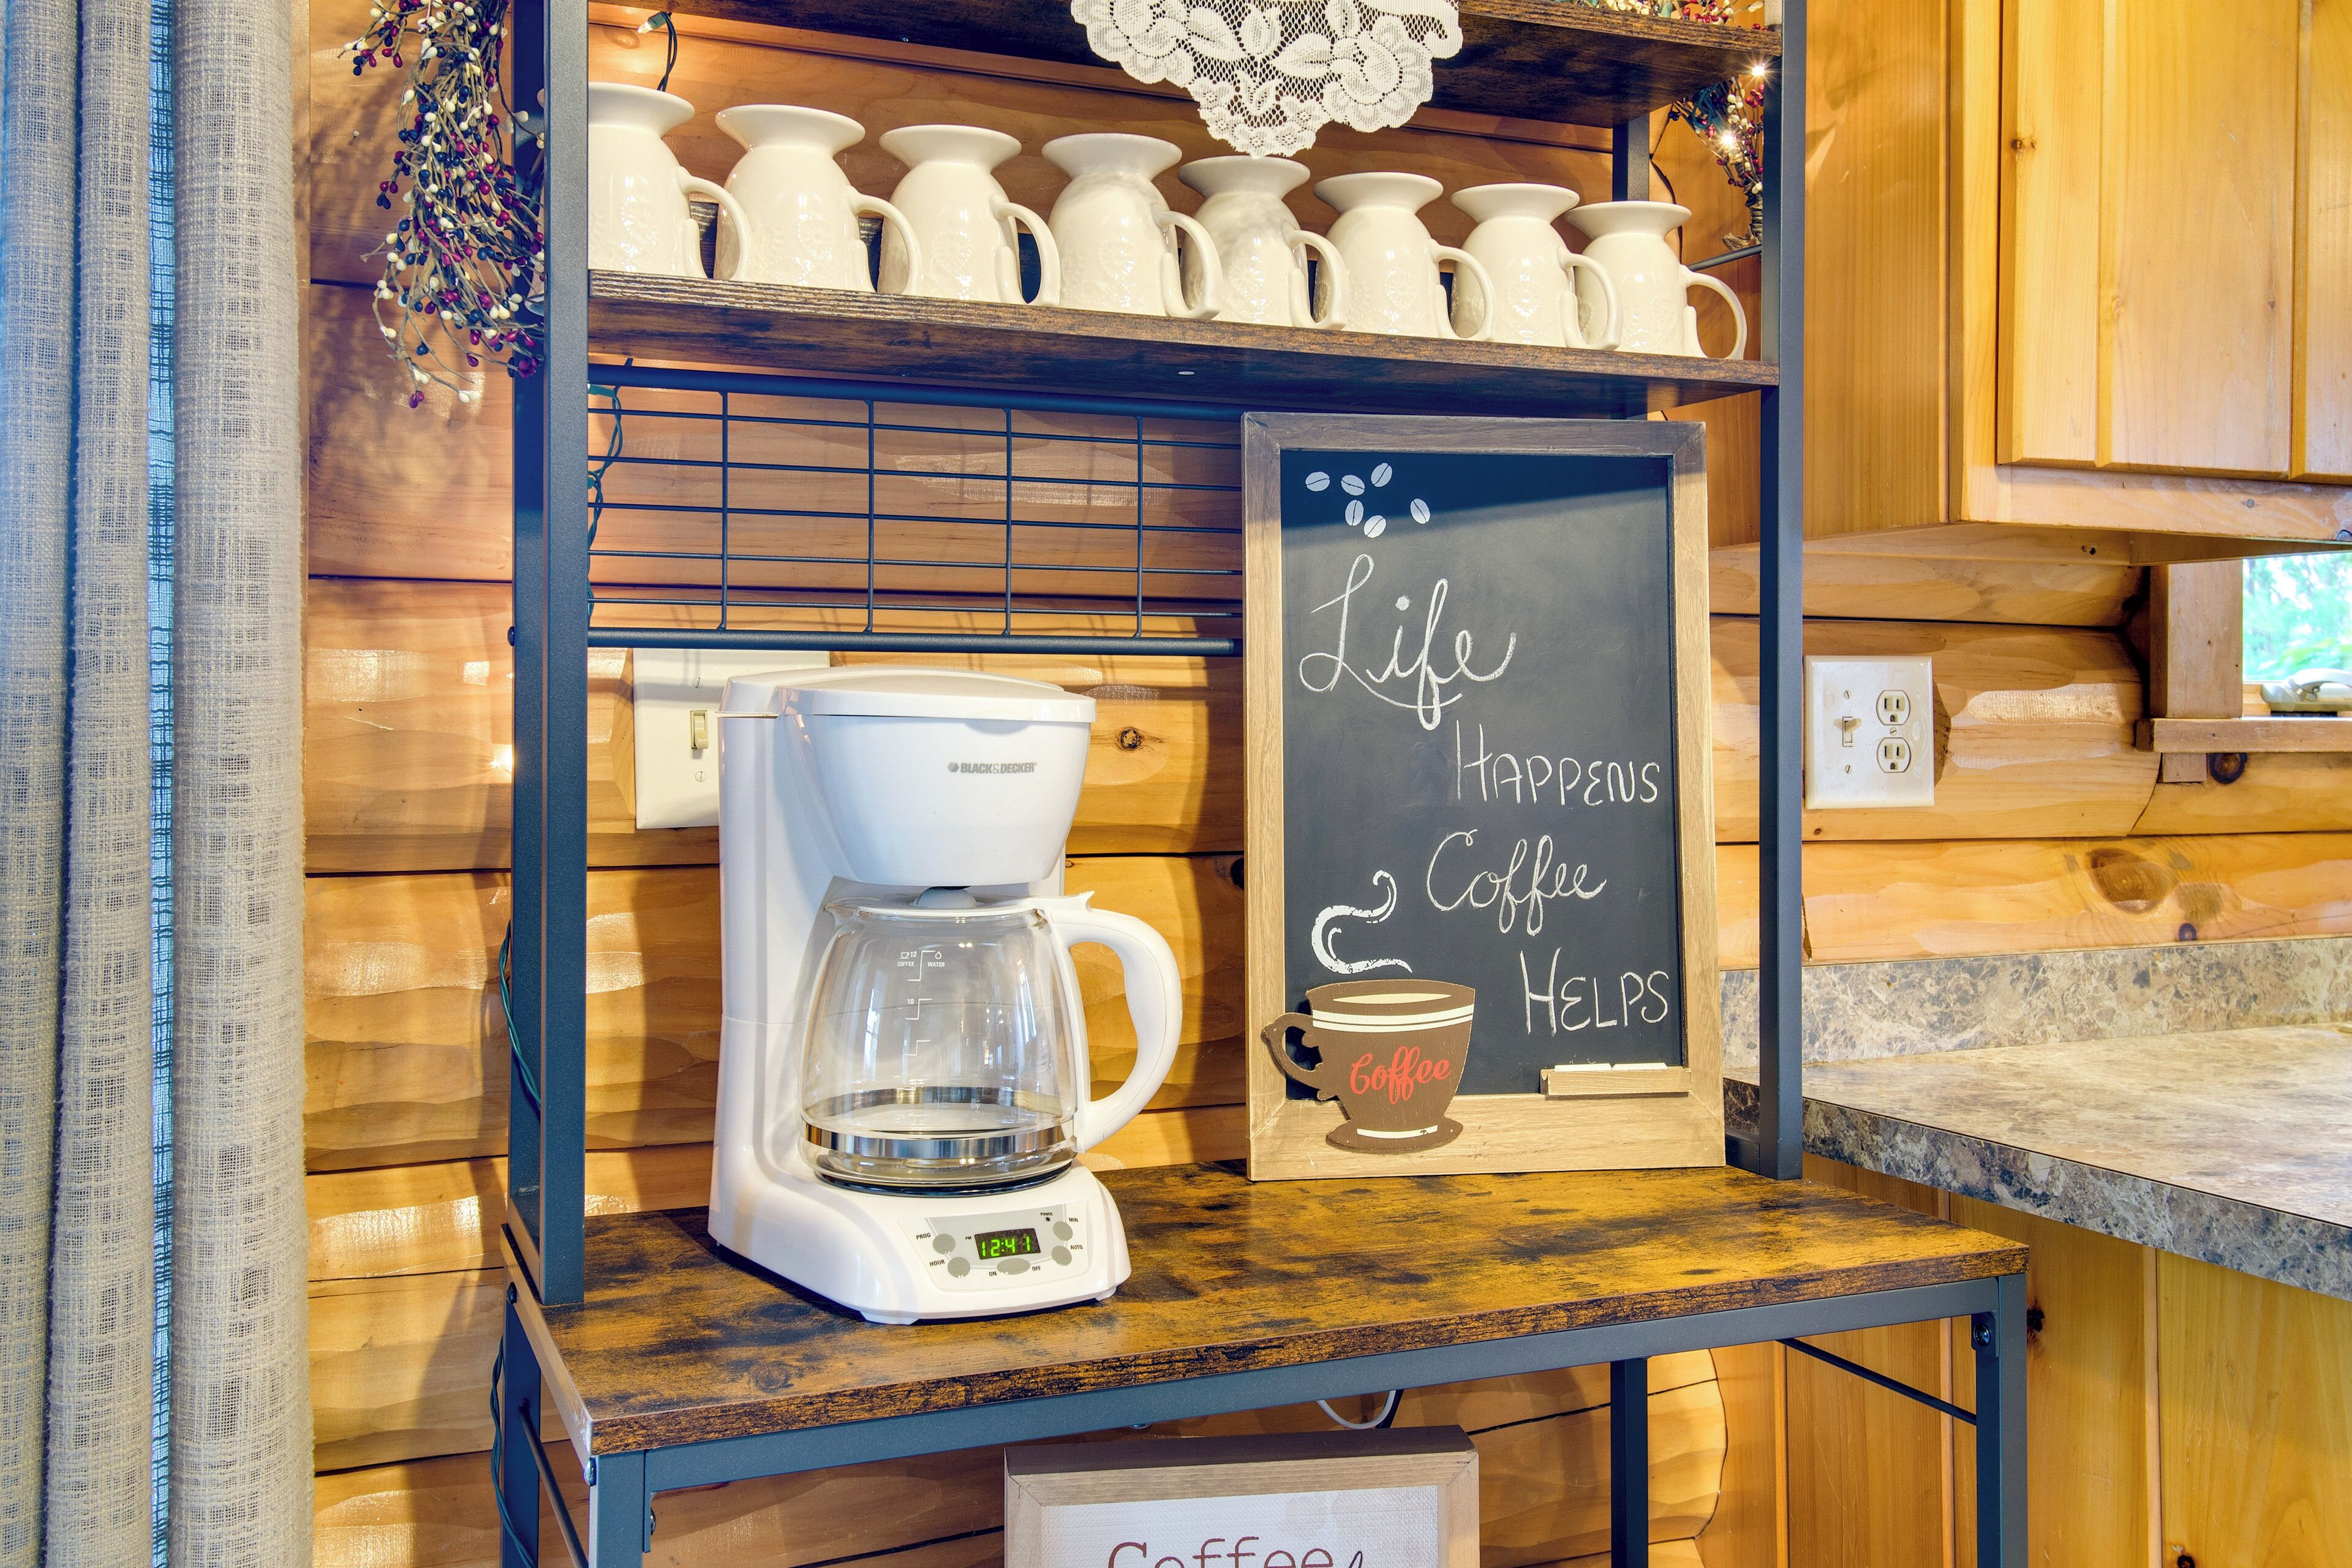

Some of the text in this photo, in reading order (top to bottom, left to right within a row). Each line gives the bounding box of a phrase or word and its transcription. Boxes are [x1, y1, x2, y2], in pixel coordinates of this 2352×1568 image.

[1298, 553, 1517, 730] Life
[1456, 719, 1660, 807] HAPPENS
[1425, 829, 1607, 937] Coffee
[1519, 946, 1670, 1036] HELPS
[1349, 1045, 1452, 1105] Coffee
[982, 1236, 1030, 1257] 12:41
